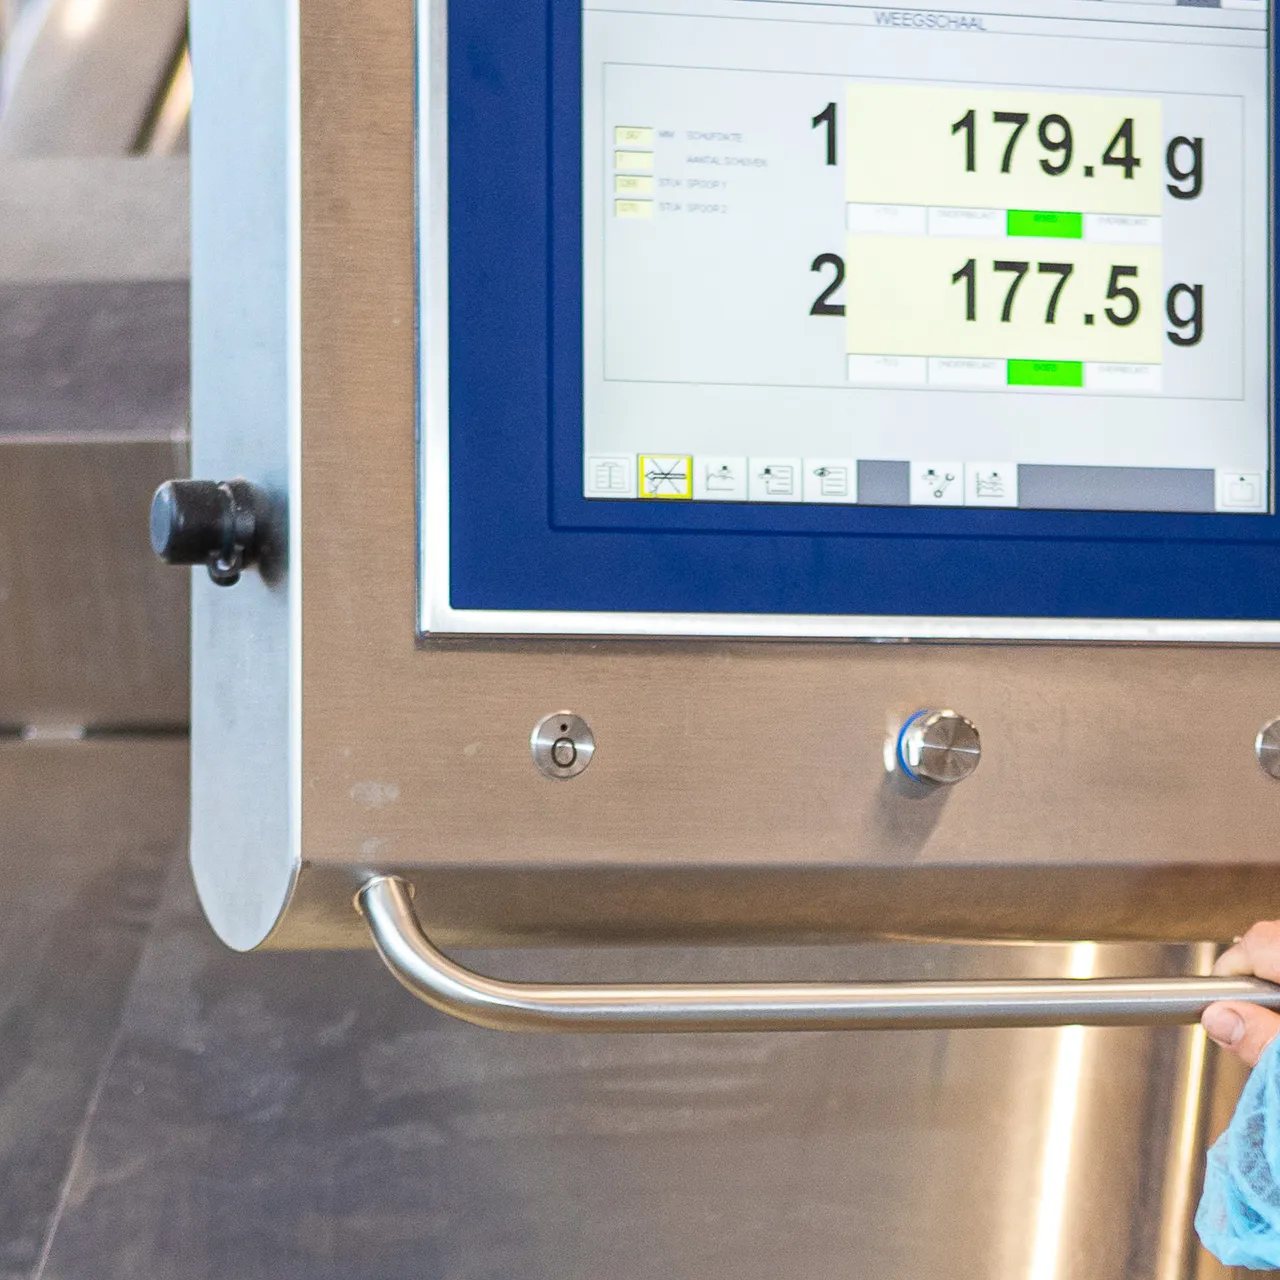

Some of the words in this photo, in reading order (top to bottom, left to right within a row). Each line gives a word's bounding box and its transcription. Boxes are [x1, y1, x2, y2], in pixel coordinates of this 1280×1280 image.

[874, 11, 987, 31] WEEGSCHAAL
[812, 102, 837, 166] 1
[951, 109, 1141, 179] 179.4
[1166, 135, 1204, 200] g
[809, 252, 846, 317] 2
[951, 258, 1141, 327] 177.5
[1166, 283, 1204, 347] g
